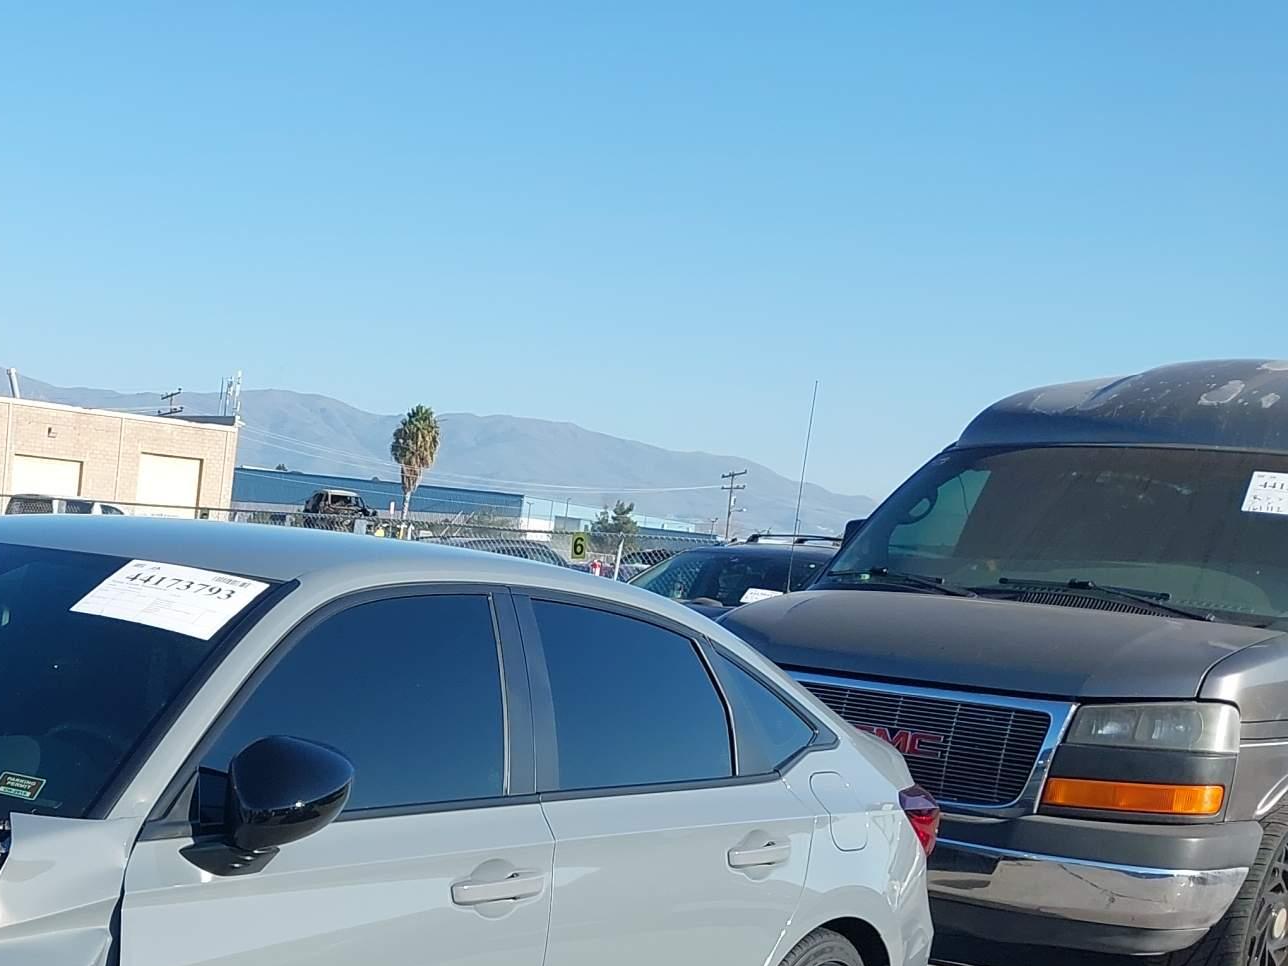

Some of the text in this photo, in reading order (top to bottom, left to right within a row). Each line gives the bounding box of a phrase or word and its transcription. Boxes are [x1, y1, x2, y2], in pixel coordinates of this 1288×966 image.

[573, 536, 584, 555] 6
[125, 572, 237, 601] 44173793
[6, 776, 37, 786] PARKING
